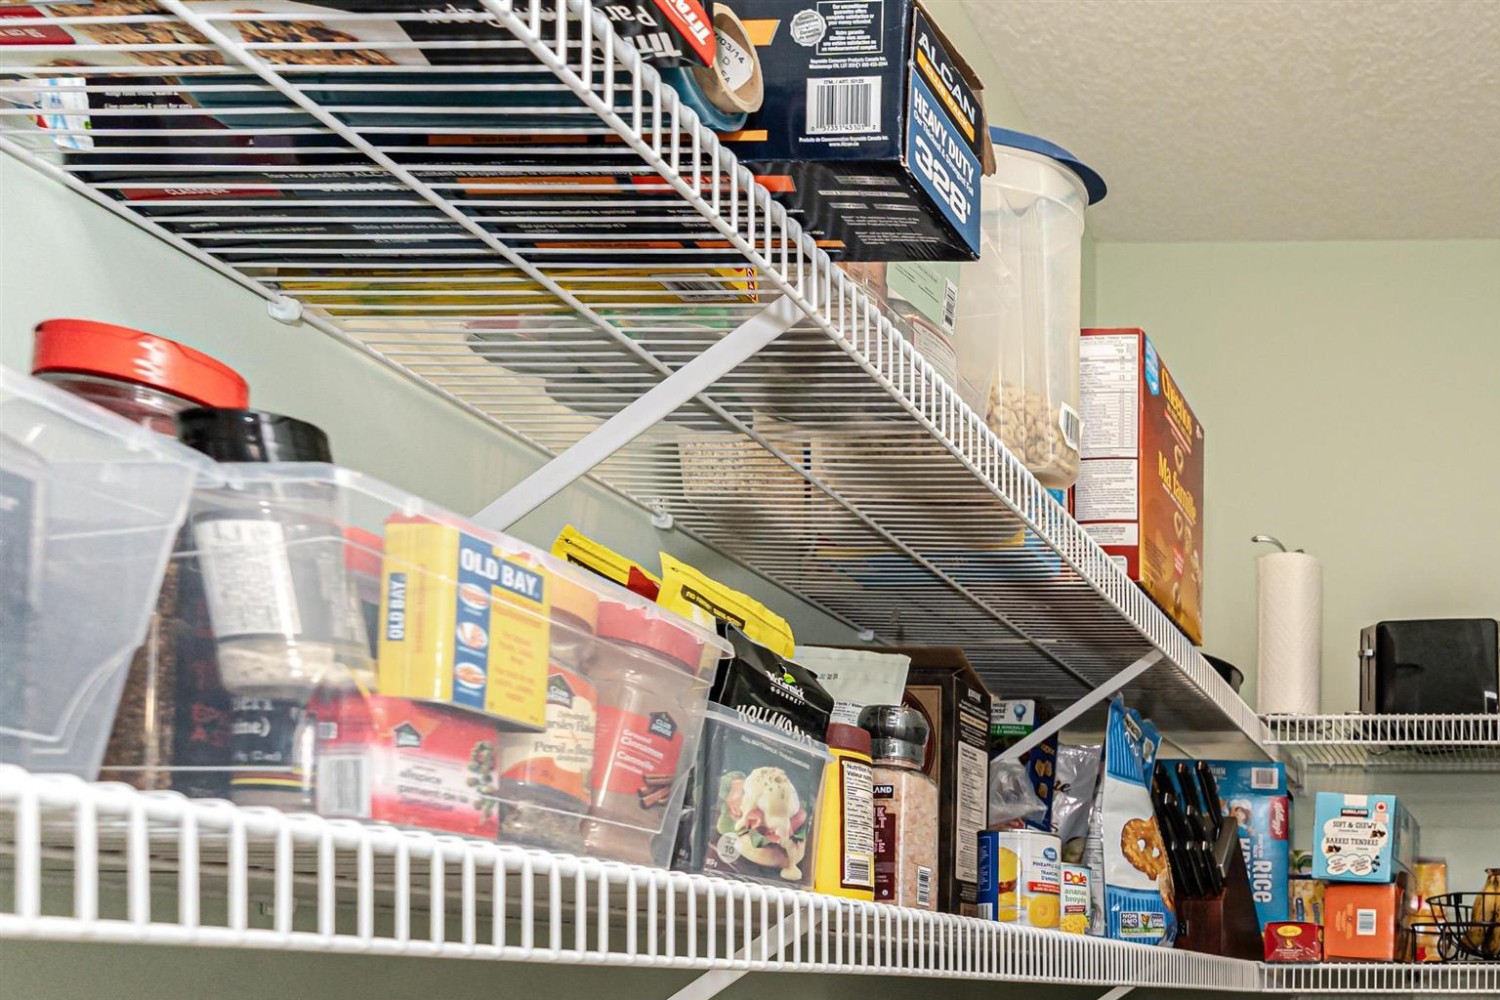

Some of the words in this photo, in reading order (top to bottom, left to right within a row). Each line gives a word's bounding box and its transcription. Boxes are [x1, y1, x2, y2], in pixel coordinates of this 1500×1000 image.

[918, 32, 976, 124] ALCAN
[914, 86, 948, 142] HEAVY
[948, 136, 974, 184] DUTY
[460, 548, 499, 580] OLD
[502, 564, 538, 596] BAY
[390, 580, 406, 611] BAY
[388, 612, 404, 640] OLD
[765, 670, 804, 701] McCormick
[770, 686, 805, 706] GOURMET
[545, 720, 574, 731] arsley
[622, 728, 652, 744] Ground
[620, 736, 664, 759] Cinnamon
[616, 751, 654, 771] Cannelle
[873, 786, 893, 794] LAND
[1272, 801, 1286, 836] Kellogg's
[1351, 838, 1379, 846] TENDRES
[1064, 870, 1087, 885] Dole
[1252, 860, 1273, 904] Rice
